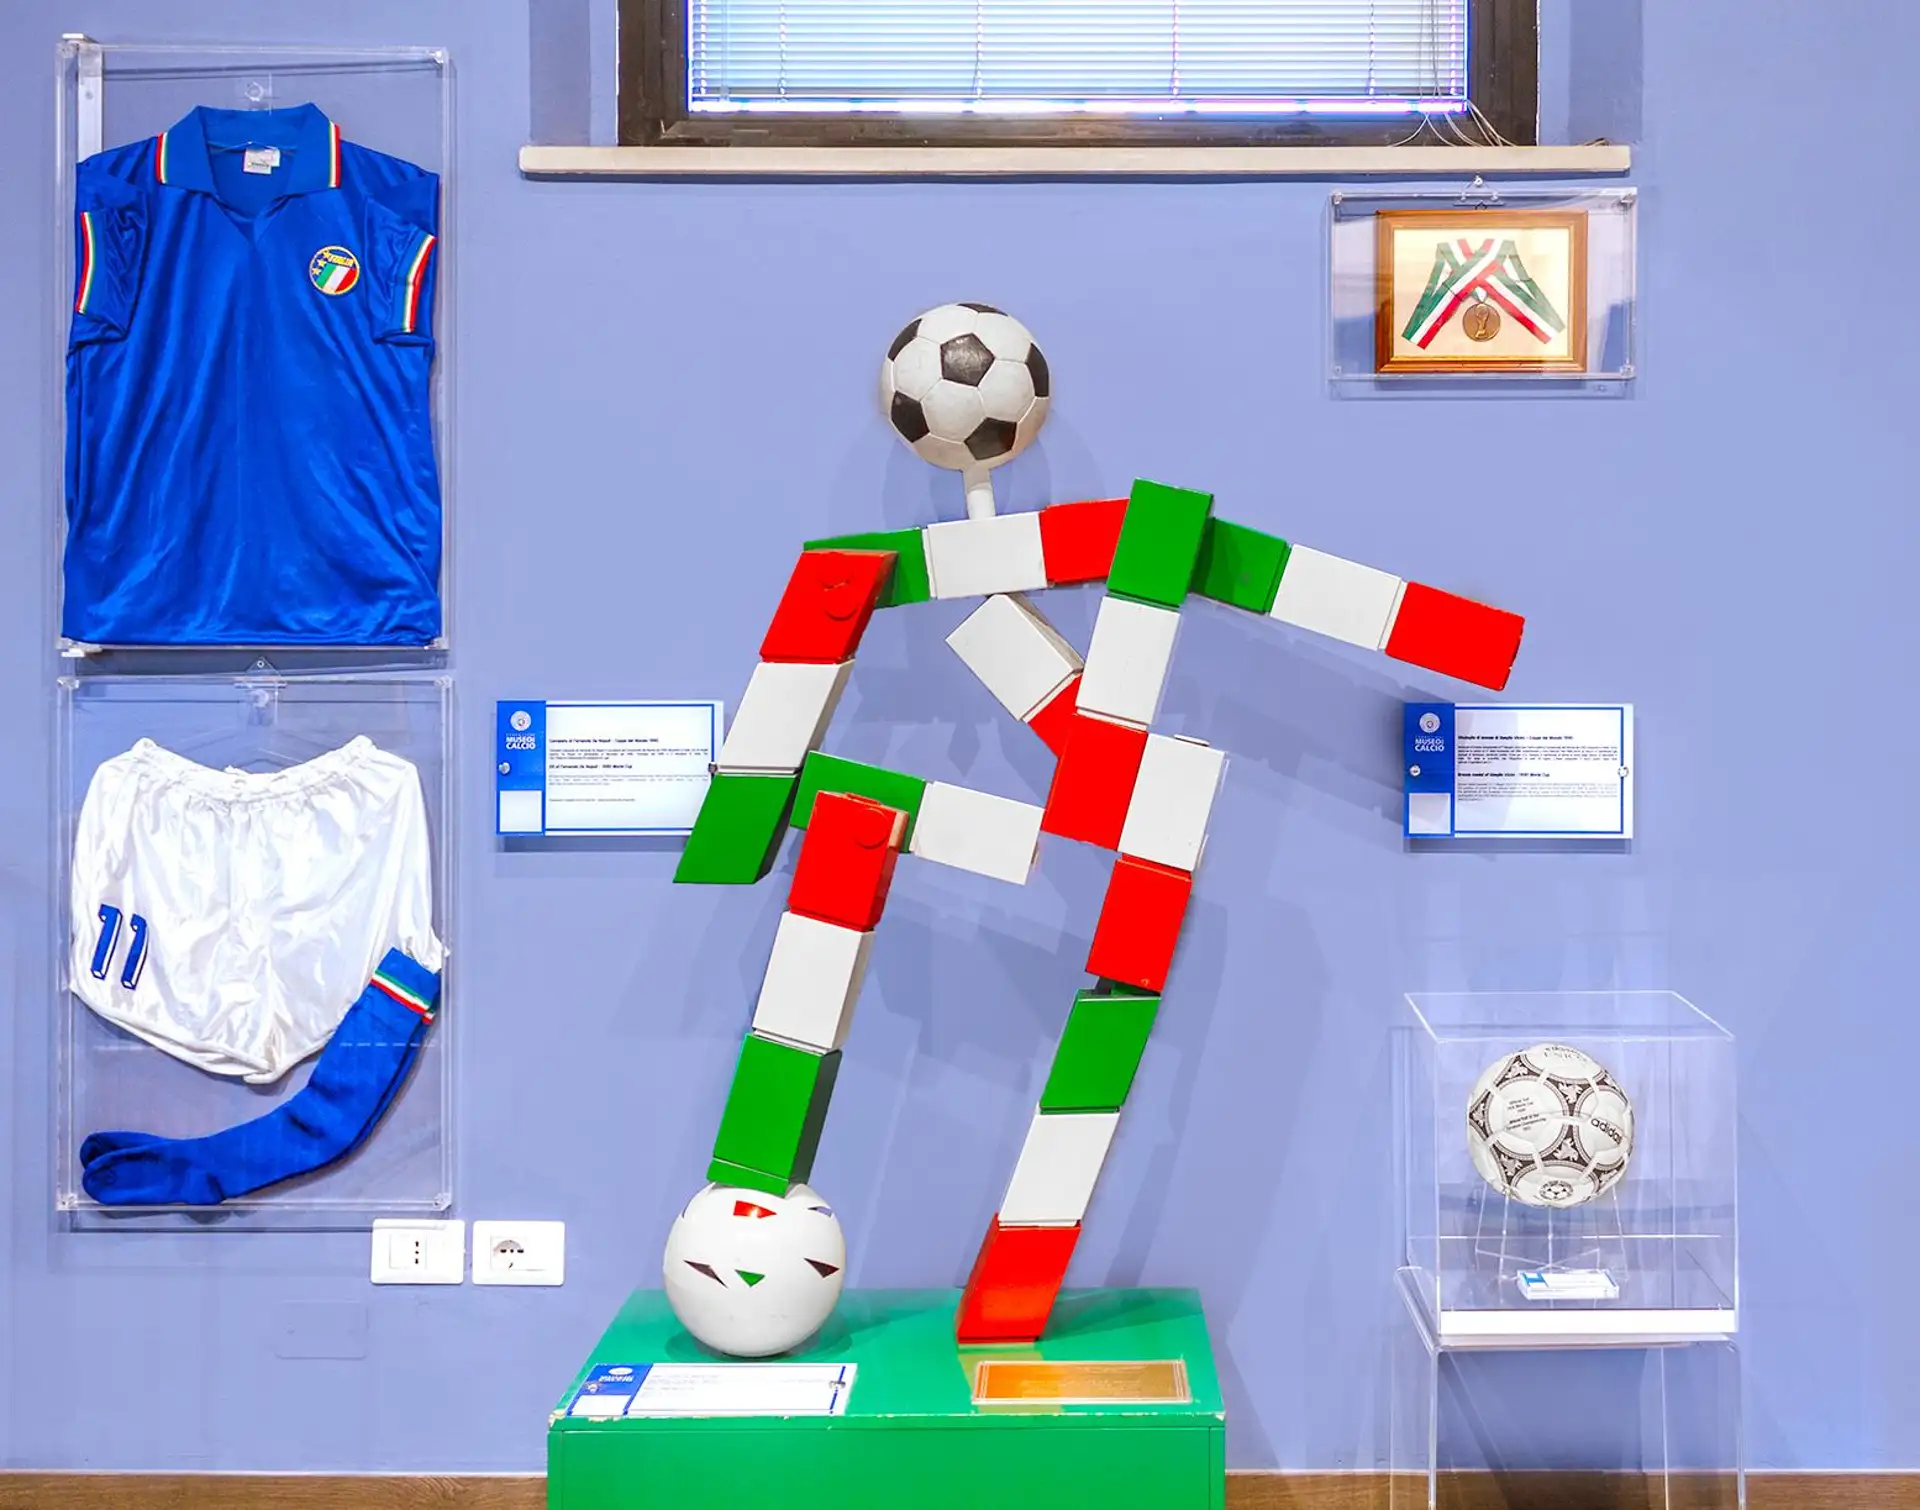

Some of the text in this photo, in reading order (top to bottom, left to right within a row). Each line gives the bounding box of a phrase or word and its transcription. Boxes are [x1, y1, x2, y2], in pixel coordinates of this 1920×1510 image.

[506, 742, 536, 750] CALCIO
[91, 904, 151, 990] 11
[1591, 1118, 1622, 1145] adidas
